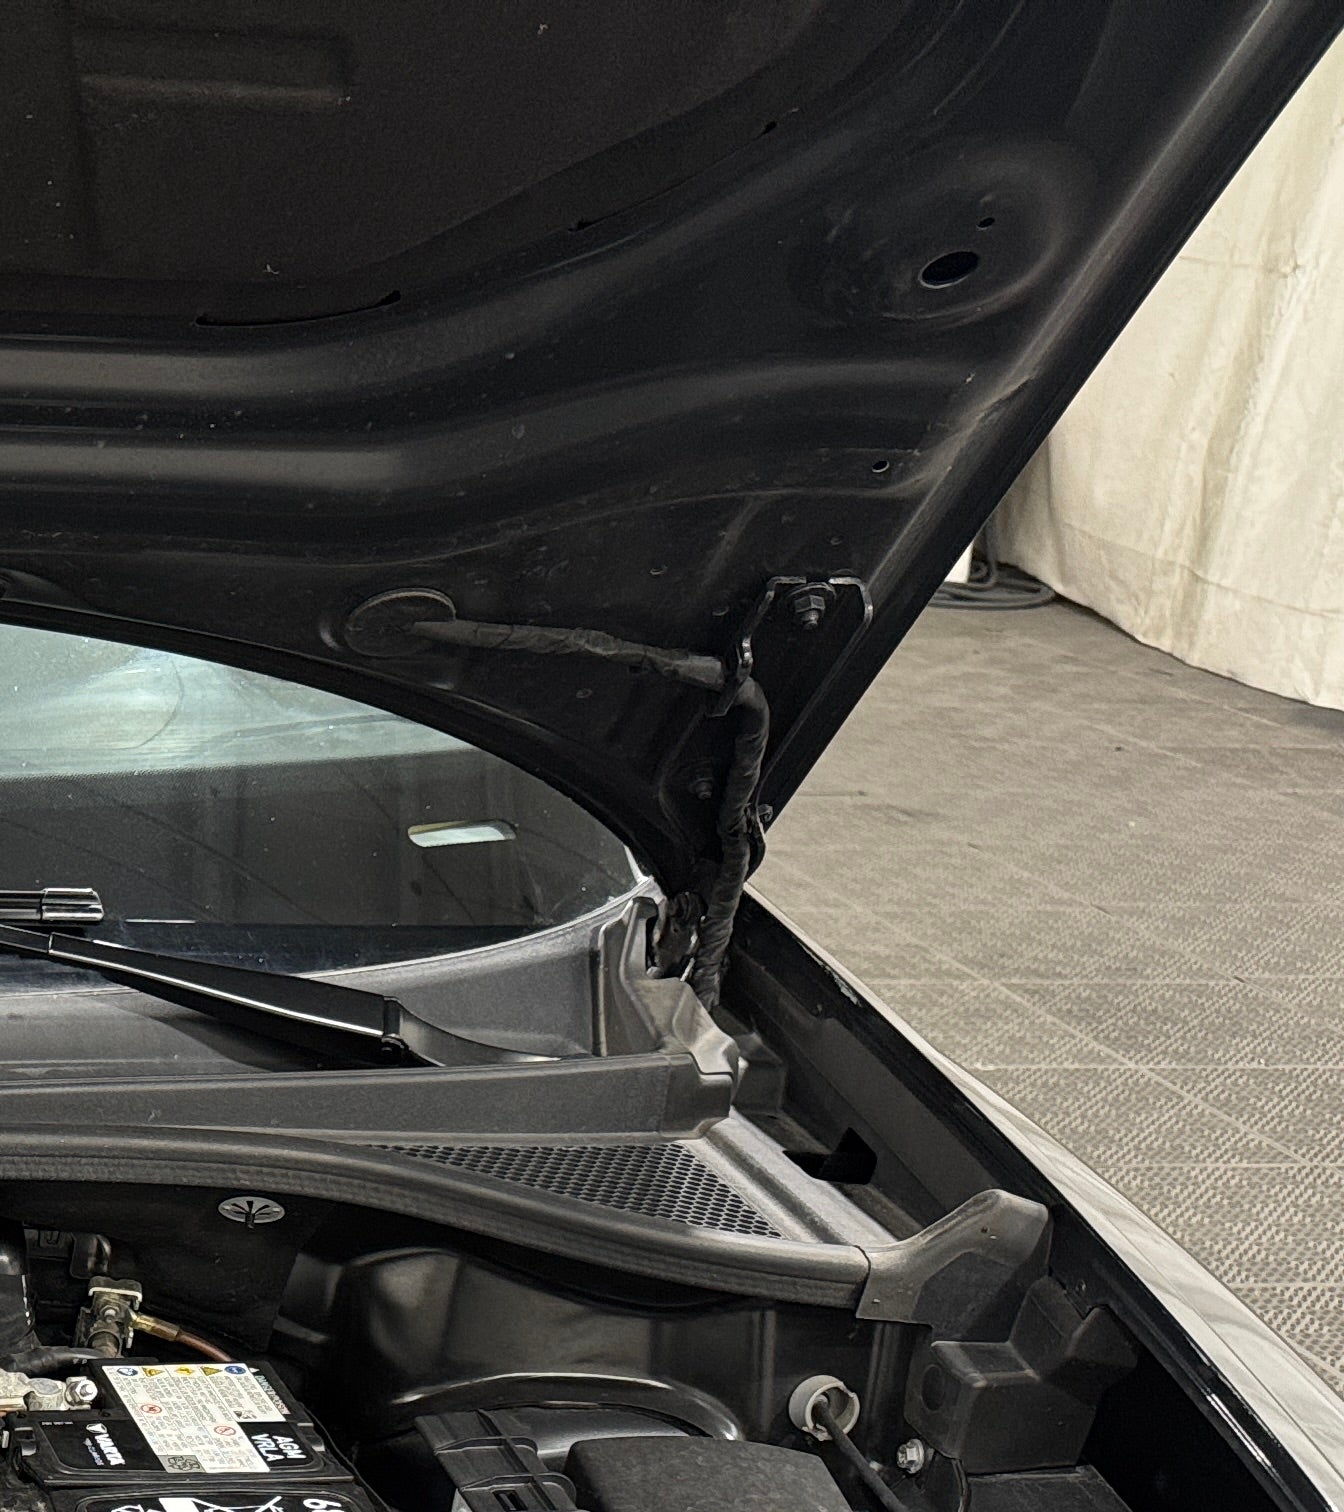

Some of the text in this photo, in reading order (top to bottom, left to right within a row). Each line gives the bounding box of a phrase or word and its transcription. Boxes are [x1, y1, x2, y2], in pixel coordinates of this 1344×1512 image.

[97, 1430, 125, 1466] VARTA
[251, 1434, 285, 1461] VRLA
[272, 1435, 306, 1458] AGM
